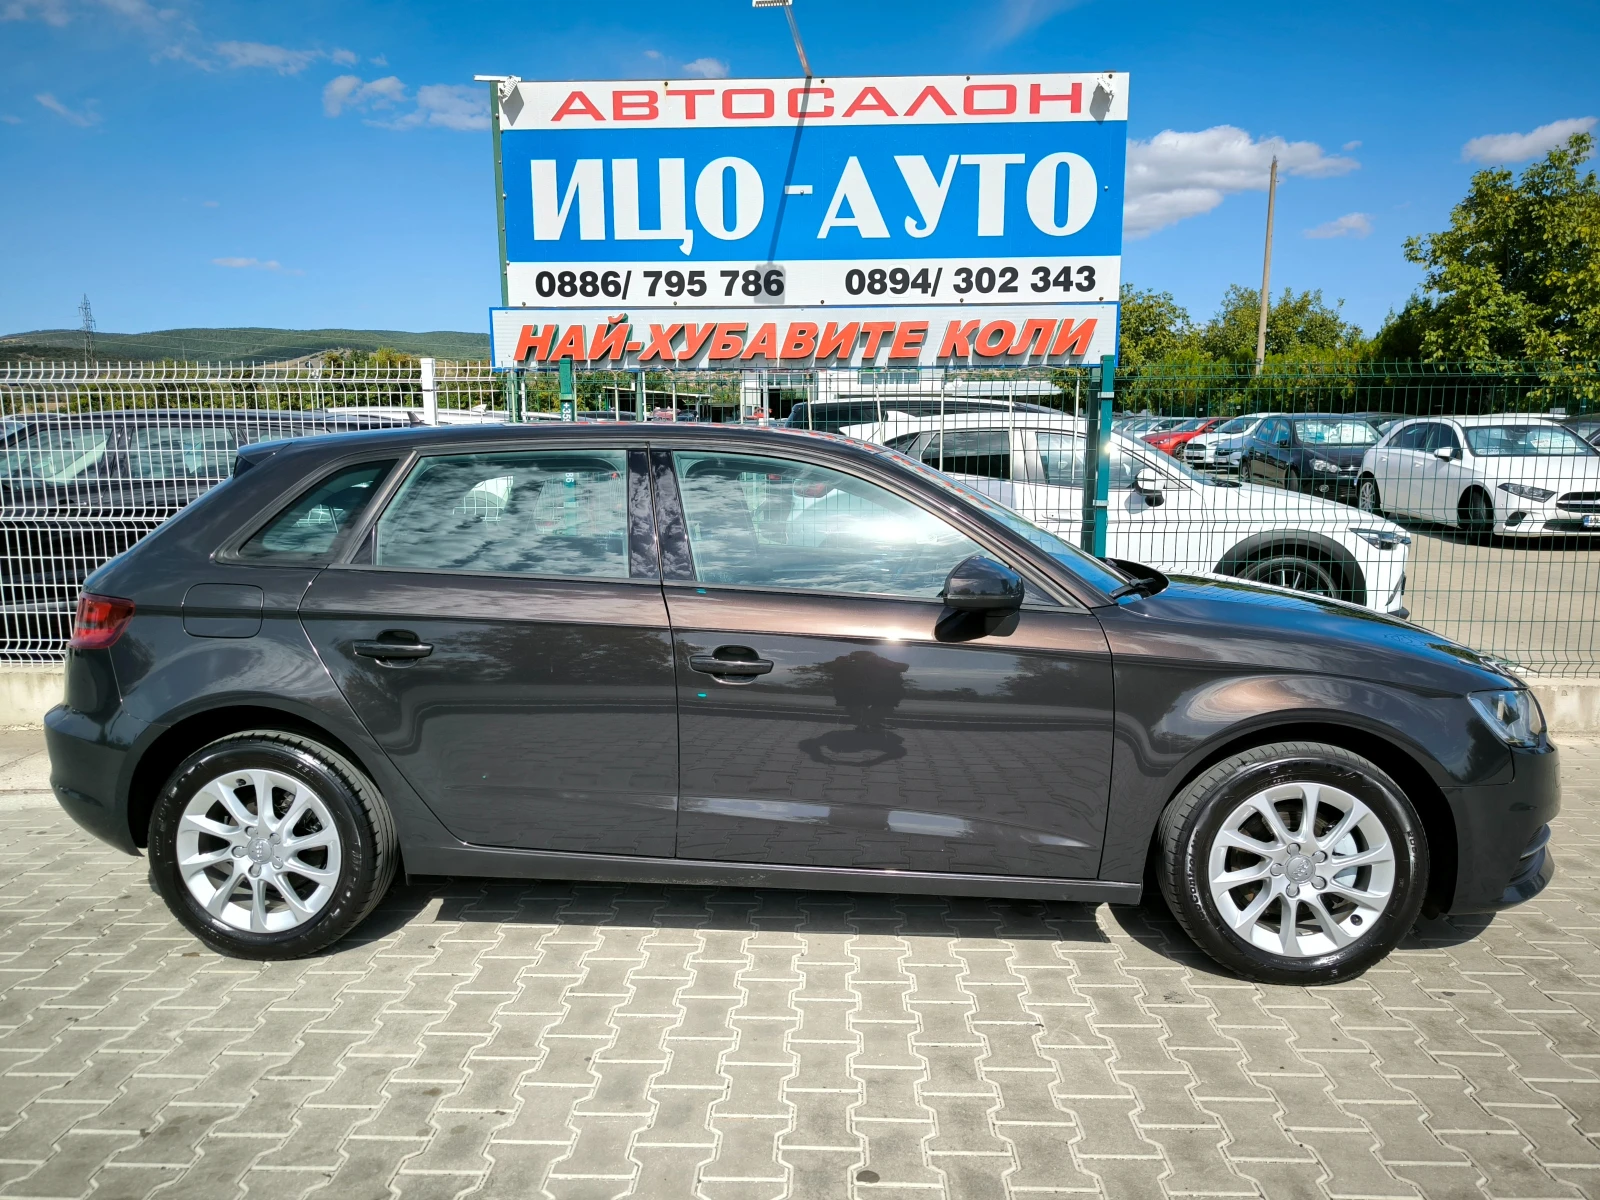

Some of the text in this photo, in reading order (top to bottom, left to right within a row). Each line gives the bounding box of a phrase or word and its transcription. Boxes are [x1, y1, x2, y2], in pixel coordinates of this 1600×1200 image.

[551, 82, 1082, 121] АВТОСАЛОН
[535, 270, 785, 300] 0886/ 795 786
[845, 265, 1096, 297] 0894/ 302 343
[513, 313, 1099, 361] НАЙ-ХУБАВИТЕ КОЛИ
